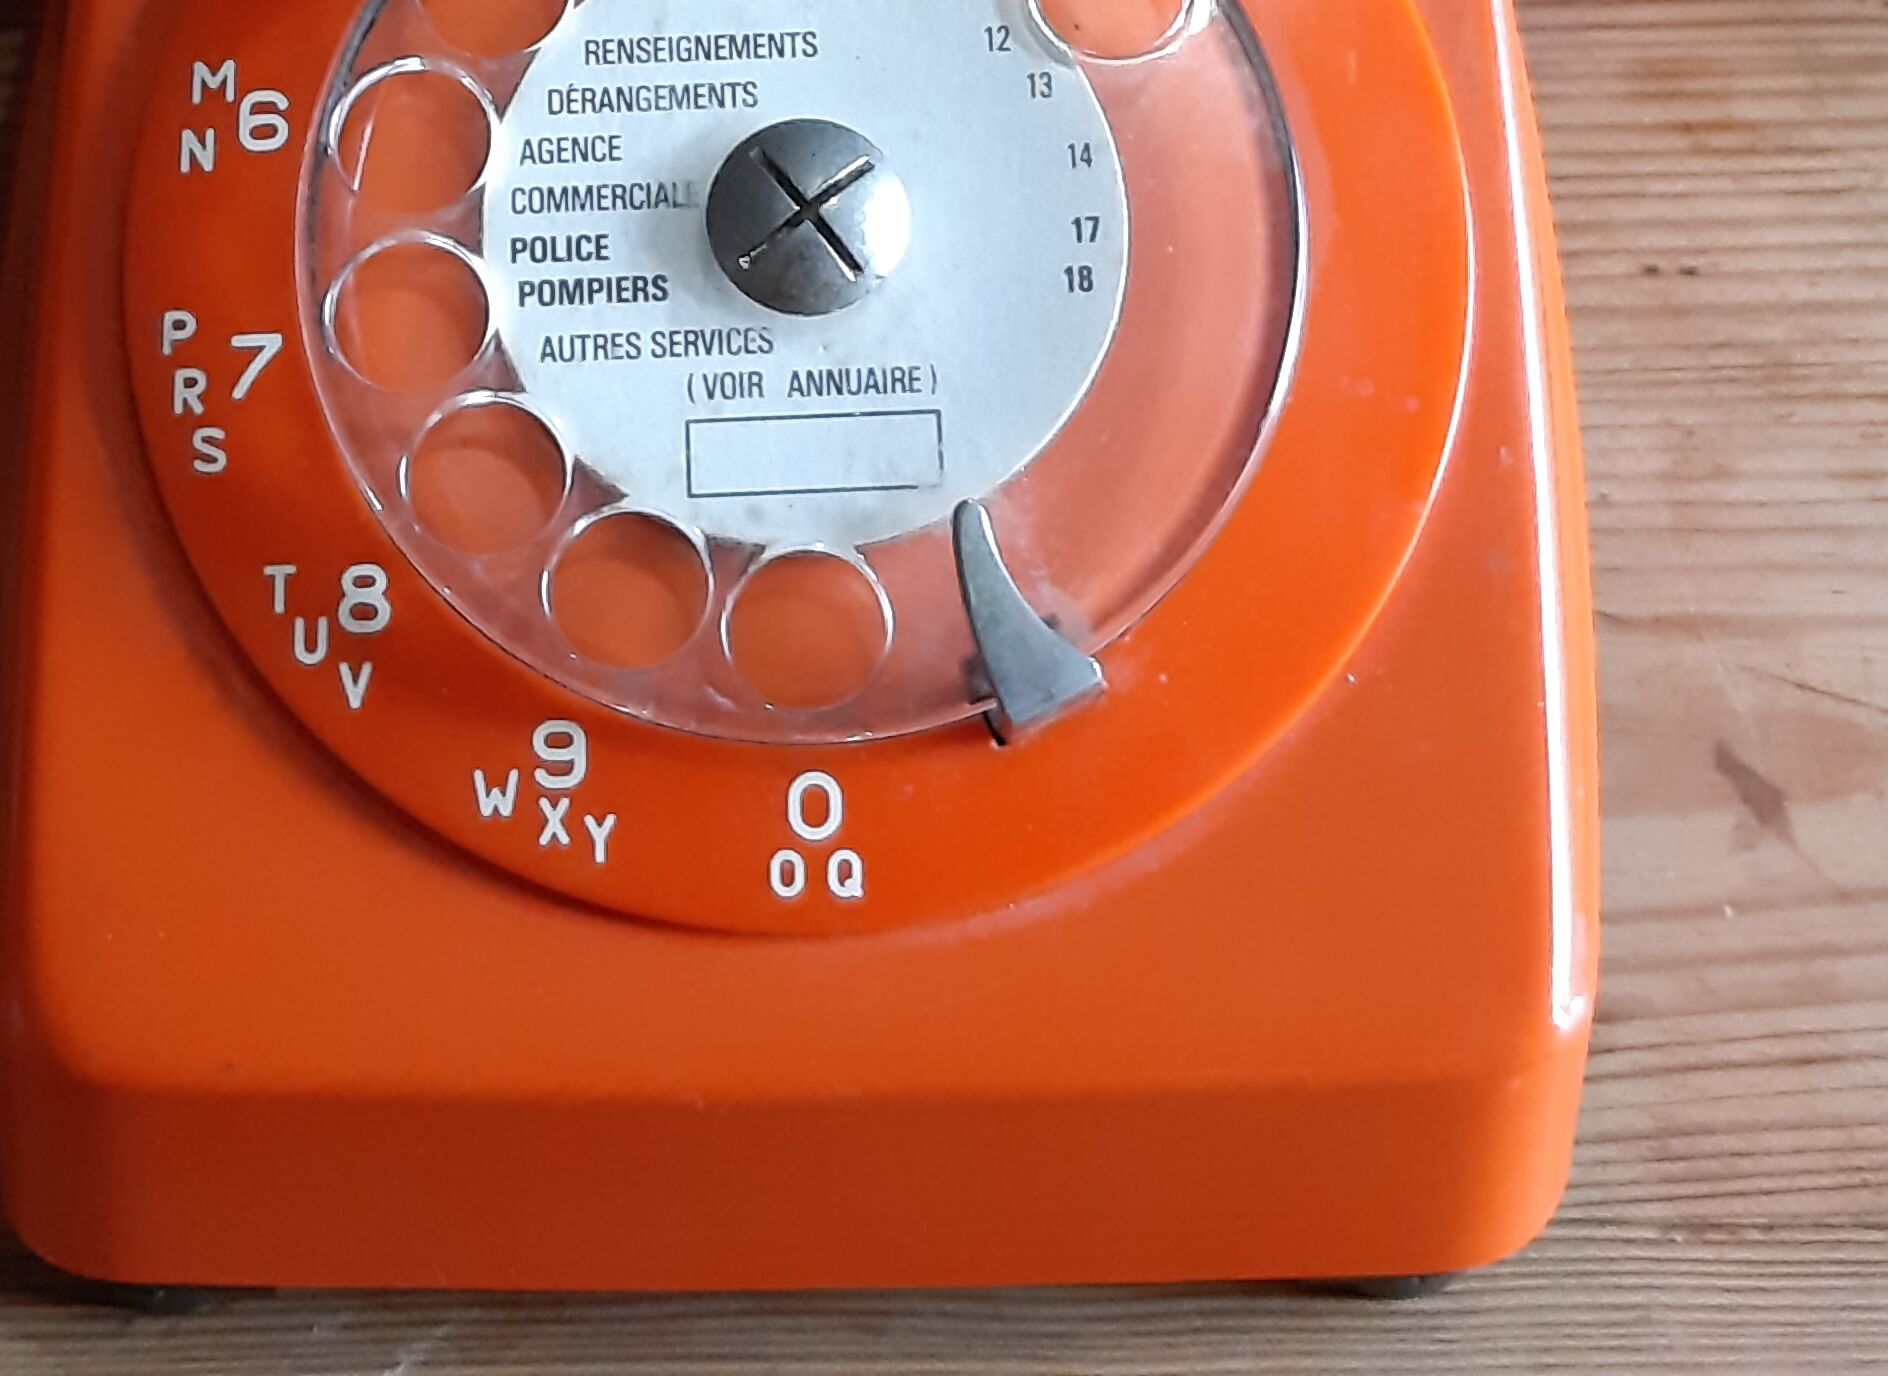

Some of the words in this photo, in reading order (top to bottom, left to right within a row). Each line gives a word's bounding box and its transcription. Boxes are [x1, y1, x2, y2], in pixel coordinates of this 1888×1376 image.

[584, 31, 818, 65] RENSEIGNEMENTS
[984, 25, 1011, 51] 12
[547, 81, 758, 115] DÉRANGEMENTS
[1027, 72, 1053, 99] 13
[238, 89, 290, 152] 6
[520, 135, 623, 165] AGENCE
[1067, 142, 1093, 169] 14
[1071, 216, 1100, 243] 17
[511, 234, 610, 264] POLICE
[518, 275, 670, 307] POMPIERS
[1064, 265, 1094, 293] 18
[540, 330, 642, 363] AUTRES
[650, 327, 775, 359] SERVICES
[230, 332, 283, 400] 7
[338, 563, 392, 633] 8
[532, 719, 587, 790] 9
